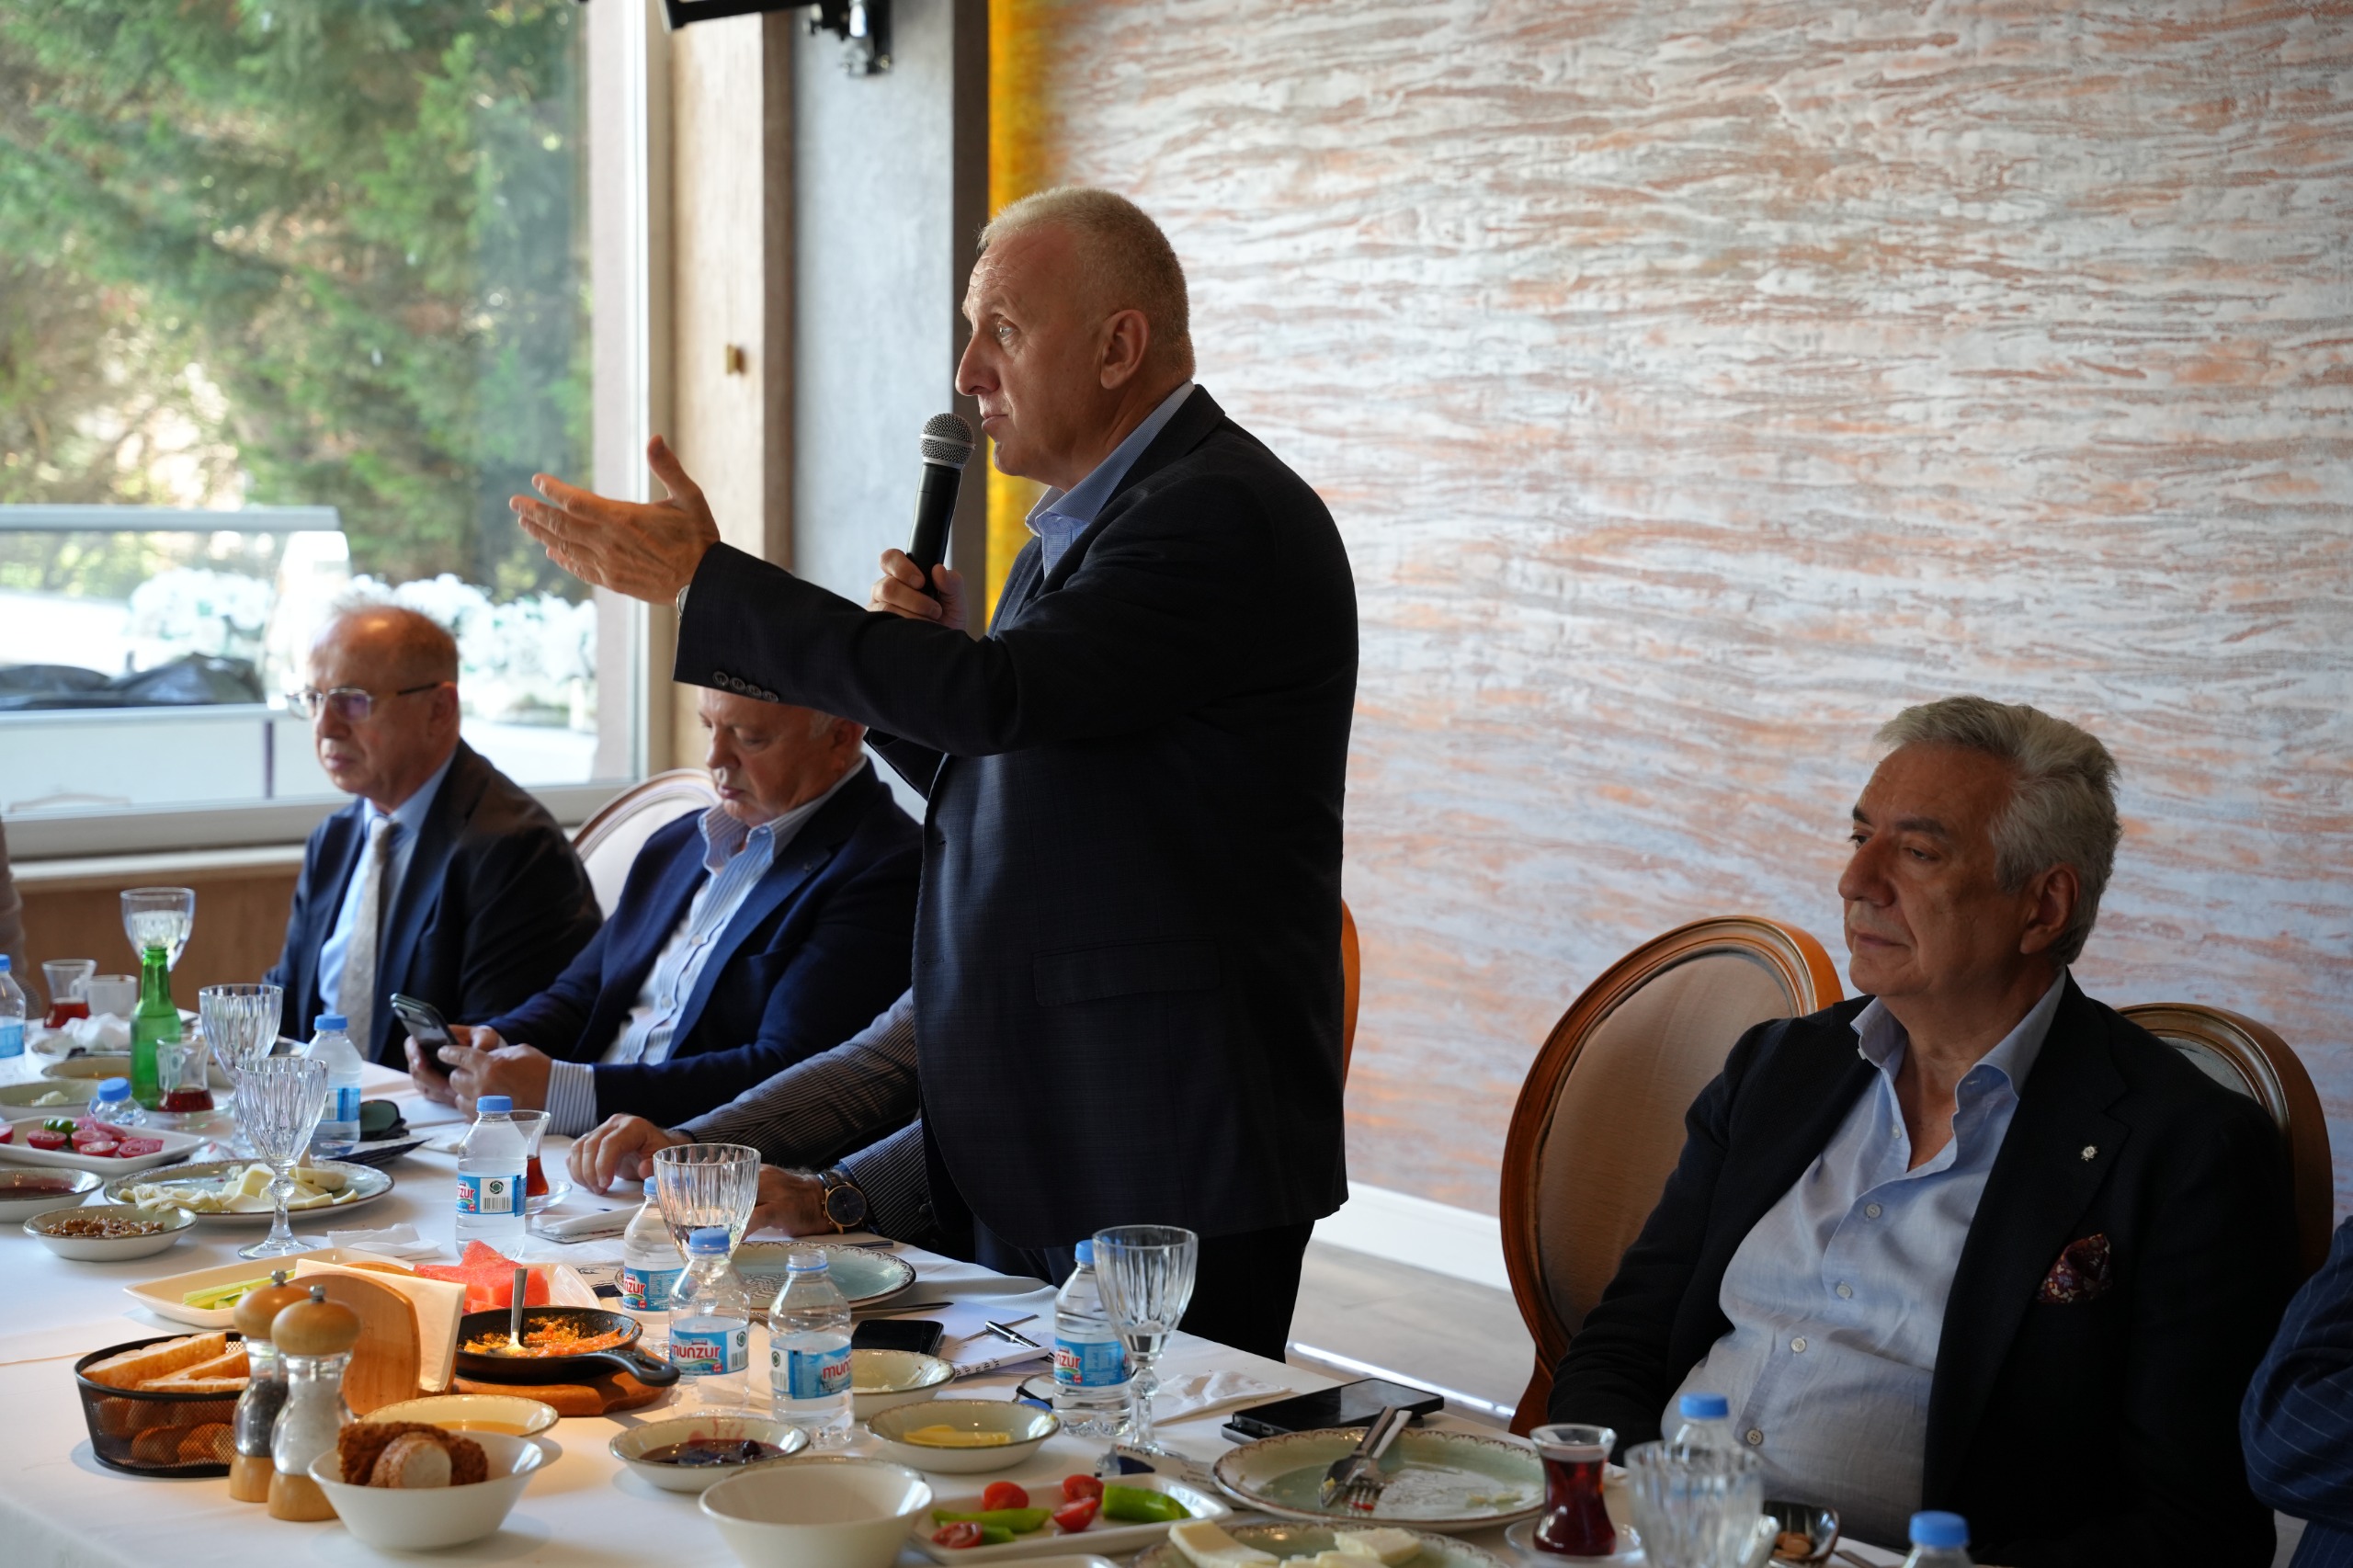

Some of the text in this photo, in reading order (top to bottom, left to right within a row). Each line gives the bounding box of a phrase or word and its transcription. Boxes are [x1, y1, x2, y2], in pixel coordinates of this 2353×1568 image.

[458, 1187, 475, 1199] zur
[624, 1281, 646, 1295] nzur
[671, 1344, 721, 1359] munzur
[1055, 1353, 1081, 1369] nzur
[823, 1359, 851, 1380] mun
